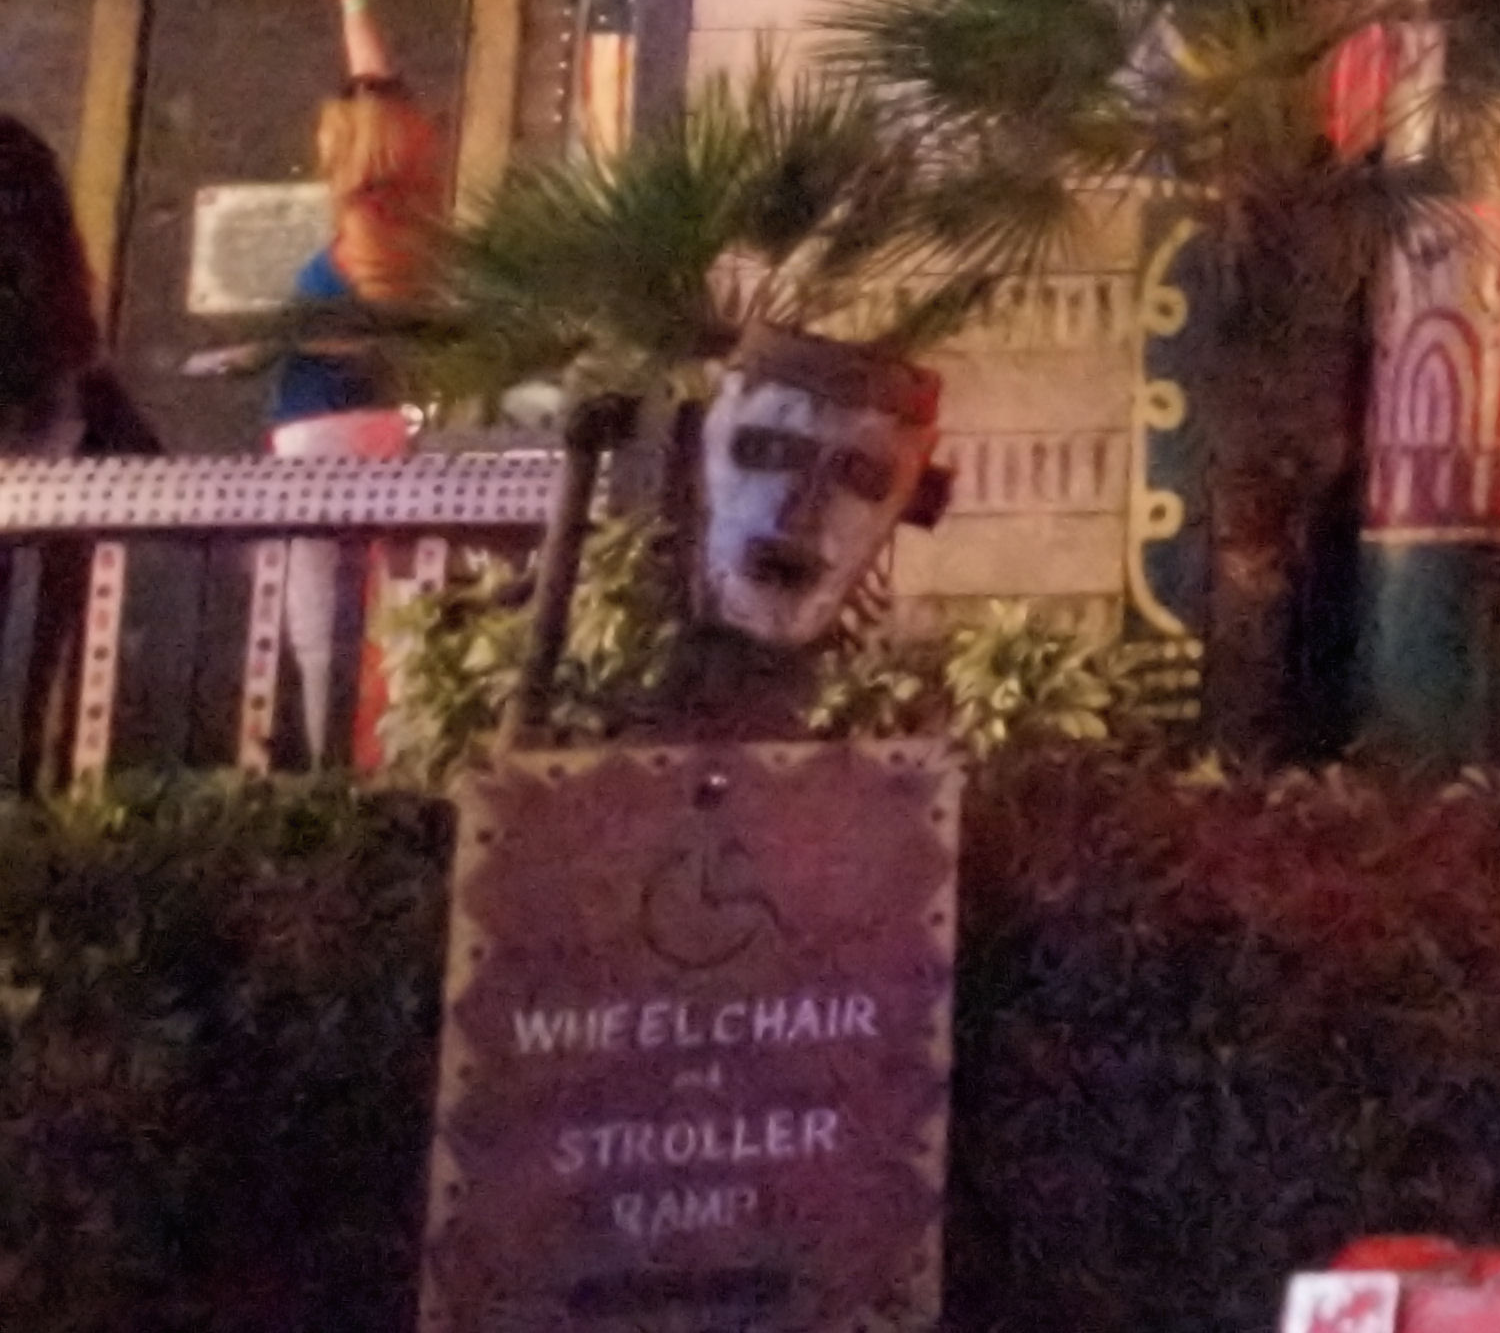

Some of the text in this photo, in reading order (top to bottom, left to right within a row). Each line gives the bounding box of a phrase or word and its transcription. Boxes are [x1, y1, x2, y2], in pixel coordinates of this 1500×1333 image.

[511, 993, 881, 1055] WHEELCHAIR
[549, 1105, 842, 1176] STROLLER
[610, 1183, 760, 1243] RAMP
